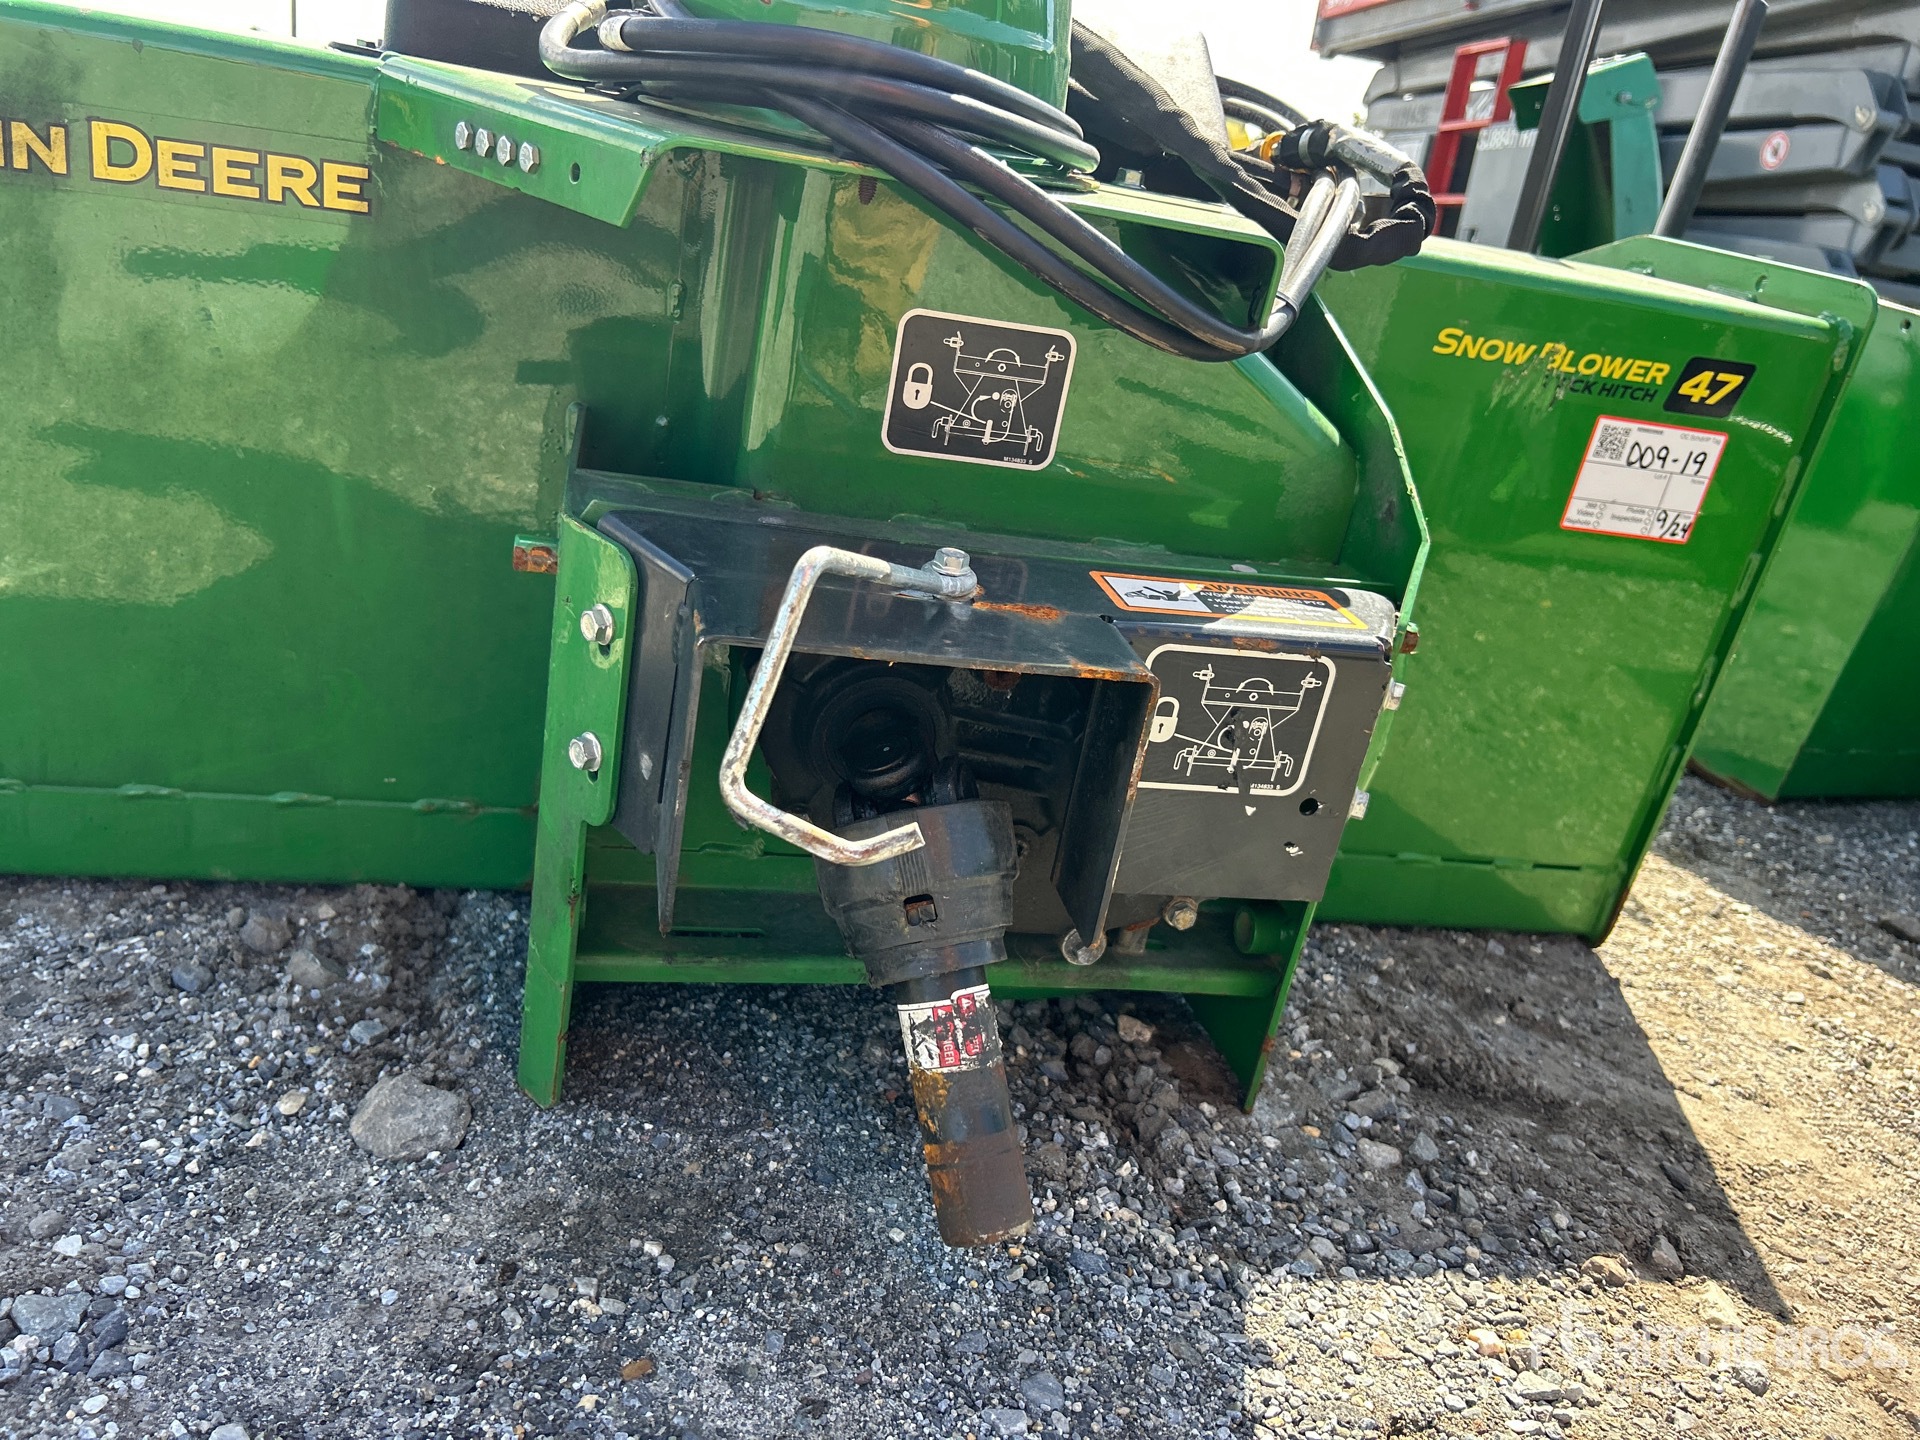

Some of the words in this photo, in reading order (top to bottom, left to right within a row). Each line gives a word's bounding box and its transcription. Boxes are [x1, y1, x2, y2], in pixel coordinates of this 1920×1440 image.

[88, 118, 371, 214] DEERE
[1431, 326, 1538, 366] SNOW
[1539, 341, 1671, 386] BLOWER
[1599, 382, 1658, 403] HITCH
[1678, 370, 1744, 406] 47
[1656, 509, 1691, 539] 9/24
[1208, 583, 1319, 600] WARNING
